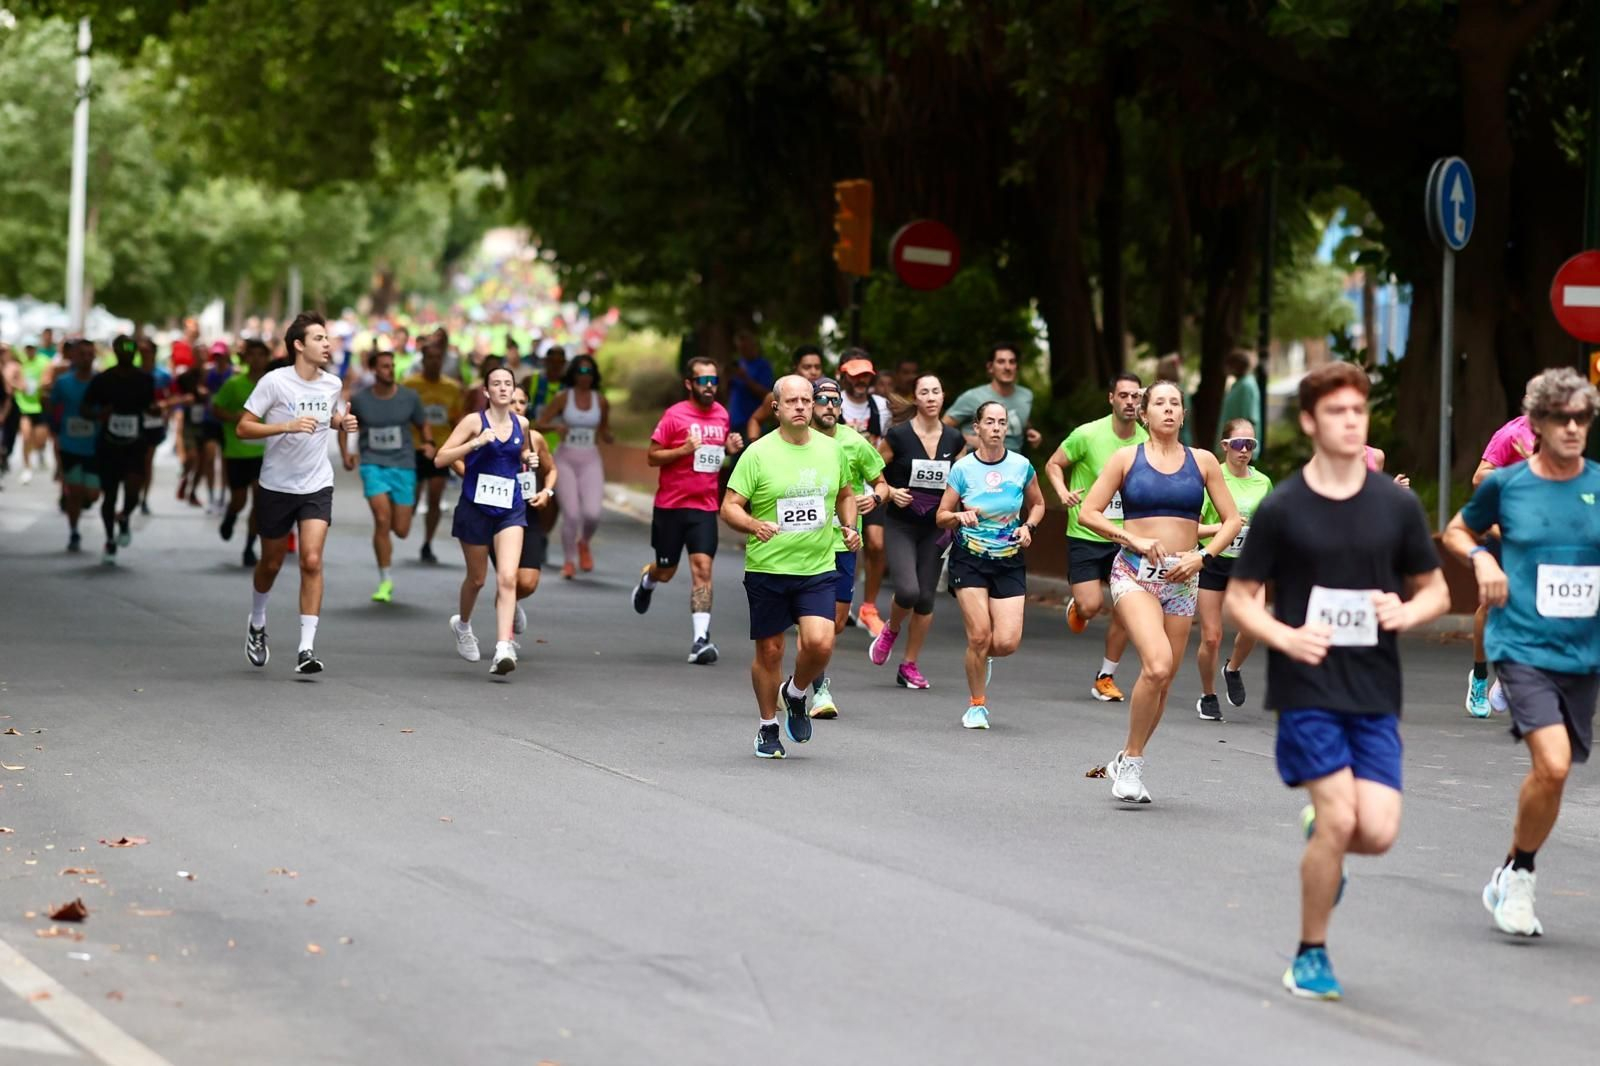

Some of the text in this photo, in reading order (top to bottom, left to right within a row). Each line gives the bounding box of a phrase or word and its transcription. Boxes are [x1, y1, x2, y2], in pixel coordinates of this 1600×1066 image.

[299, 402, 328, 412] 1112
[699, 454, 721, 465] 566
[916, 470, 944, 481] 639
[481, 484, 509, 497] 1111
[1110, 500, 1122, 509] 19
[784, 509, 818, 523] 226
[1146, 567, 1169, 580] 79
[1545, 584, 1594, 598] 1037
[1319, 608, 1367, 627] 502
